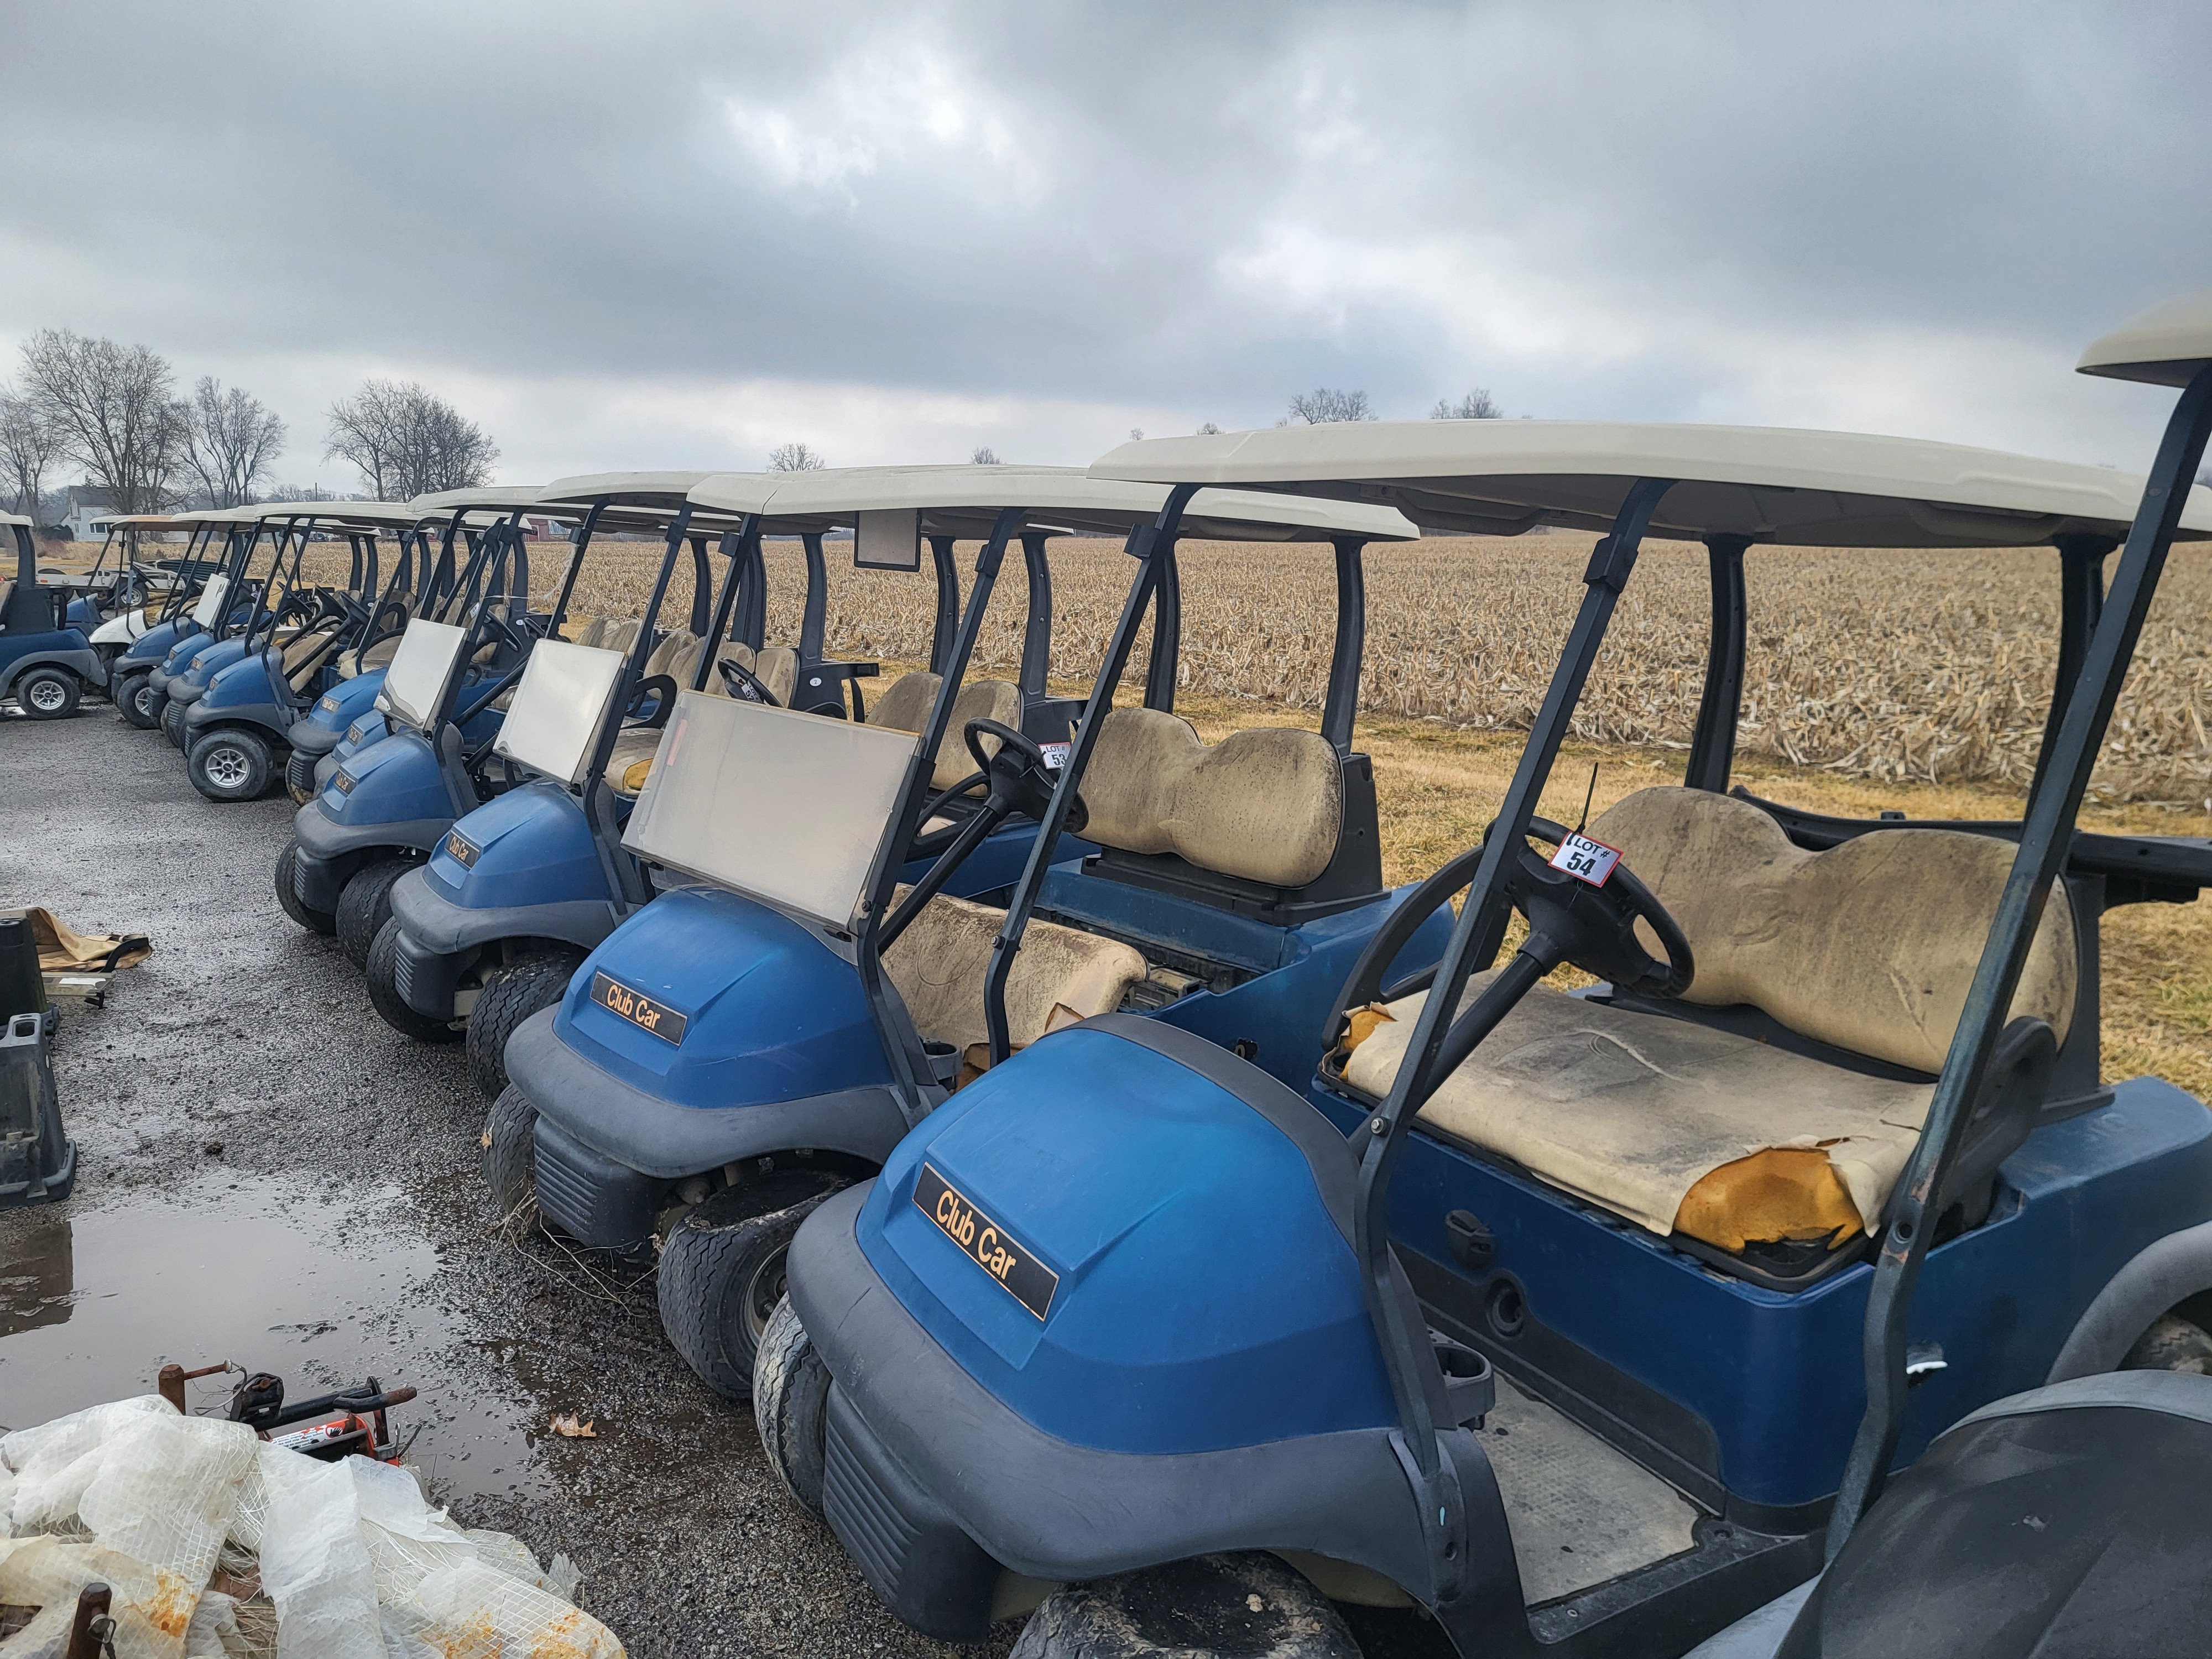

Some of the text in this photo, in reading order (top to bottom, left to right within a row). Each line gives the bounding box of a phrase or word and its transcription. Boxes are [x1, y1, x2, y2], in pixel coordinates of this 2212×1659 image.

[746, 690, 755, 701] 52
[1051, 754, 1066, 766] 53
[449, 836, 469, 861] Club Car
[1573, 837, 1611, 858] LOT #
[1566, 851, 1597, 877] 54
[607, 984, 661, 1029] Club Car
[936, 1190, 1017, 1275] Club Car
